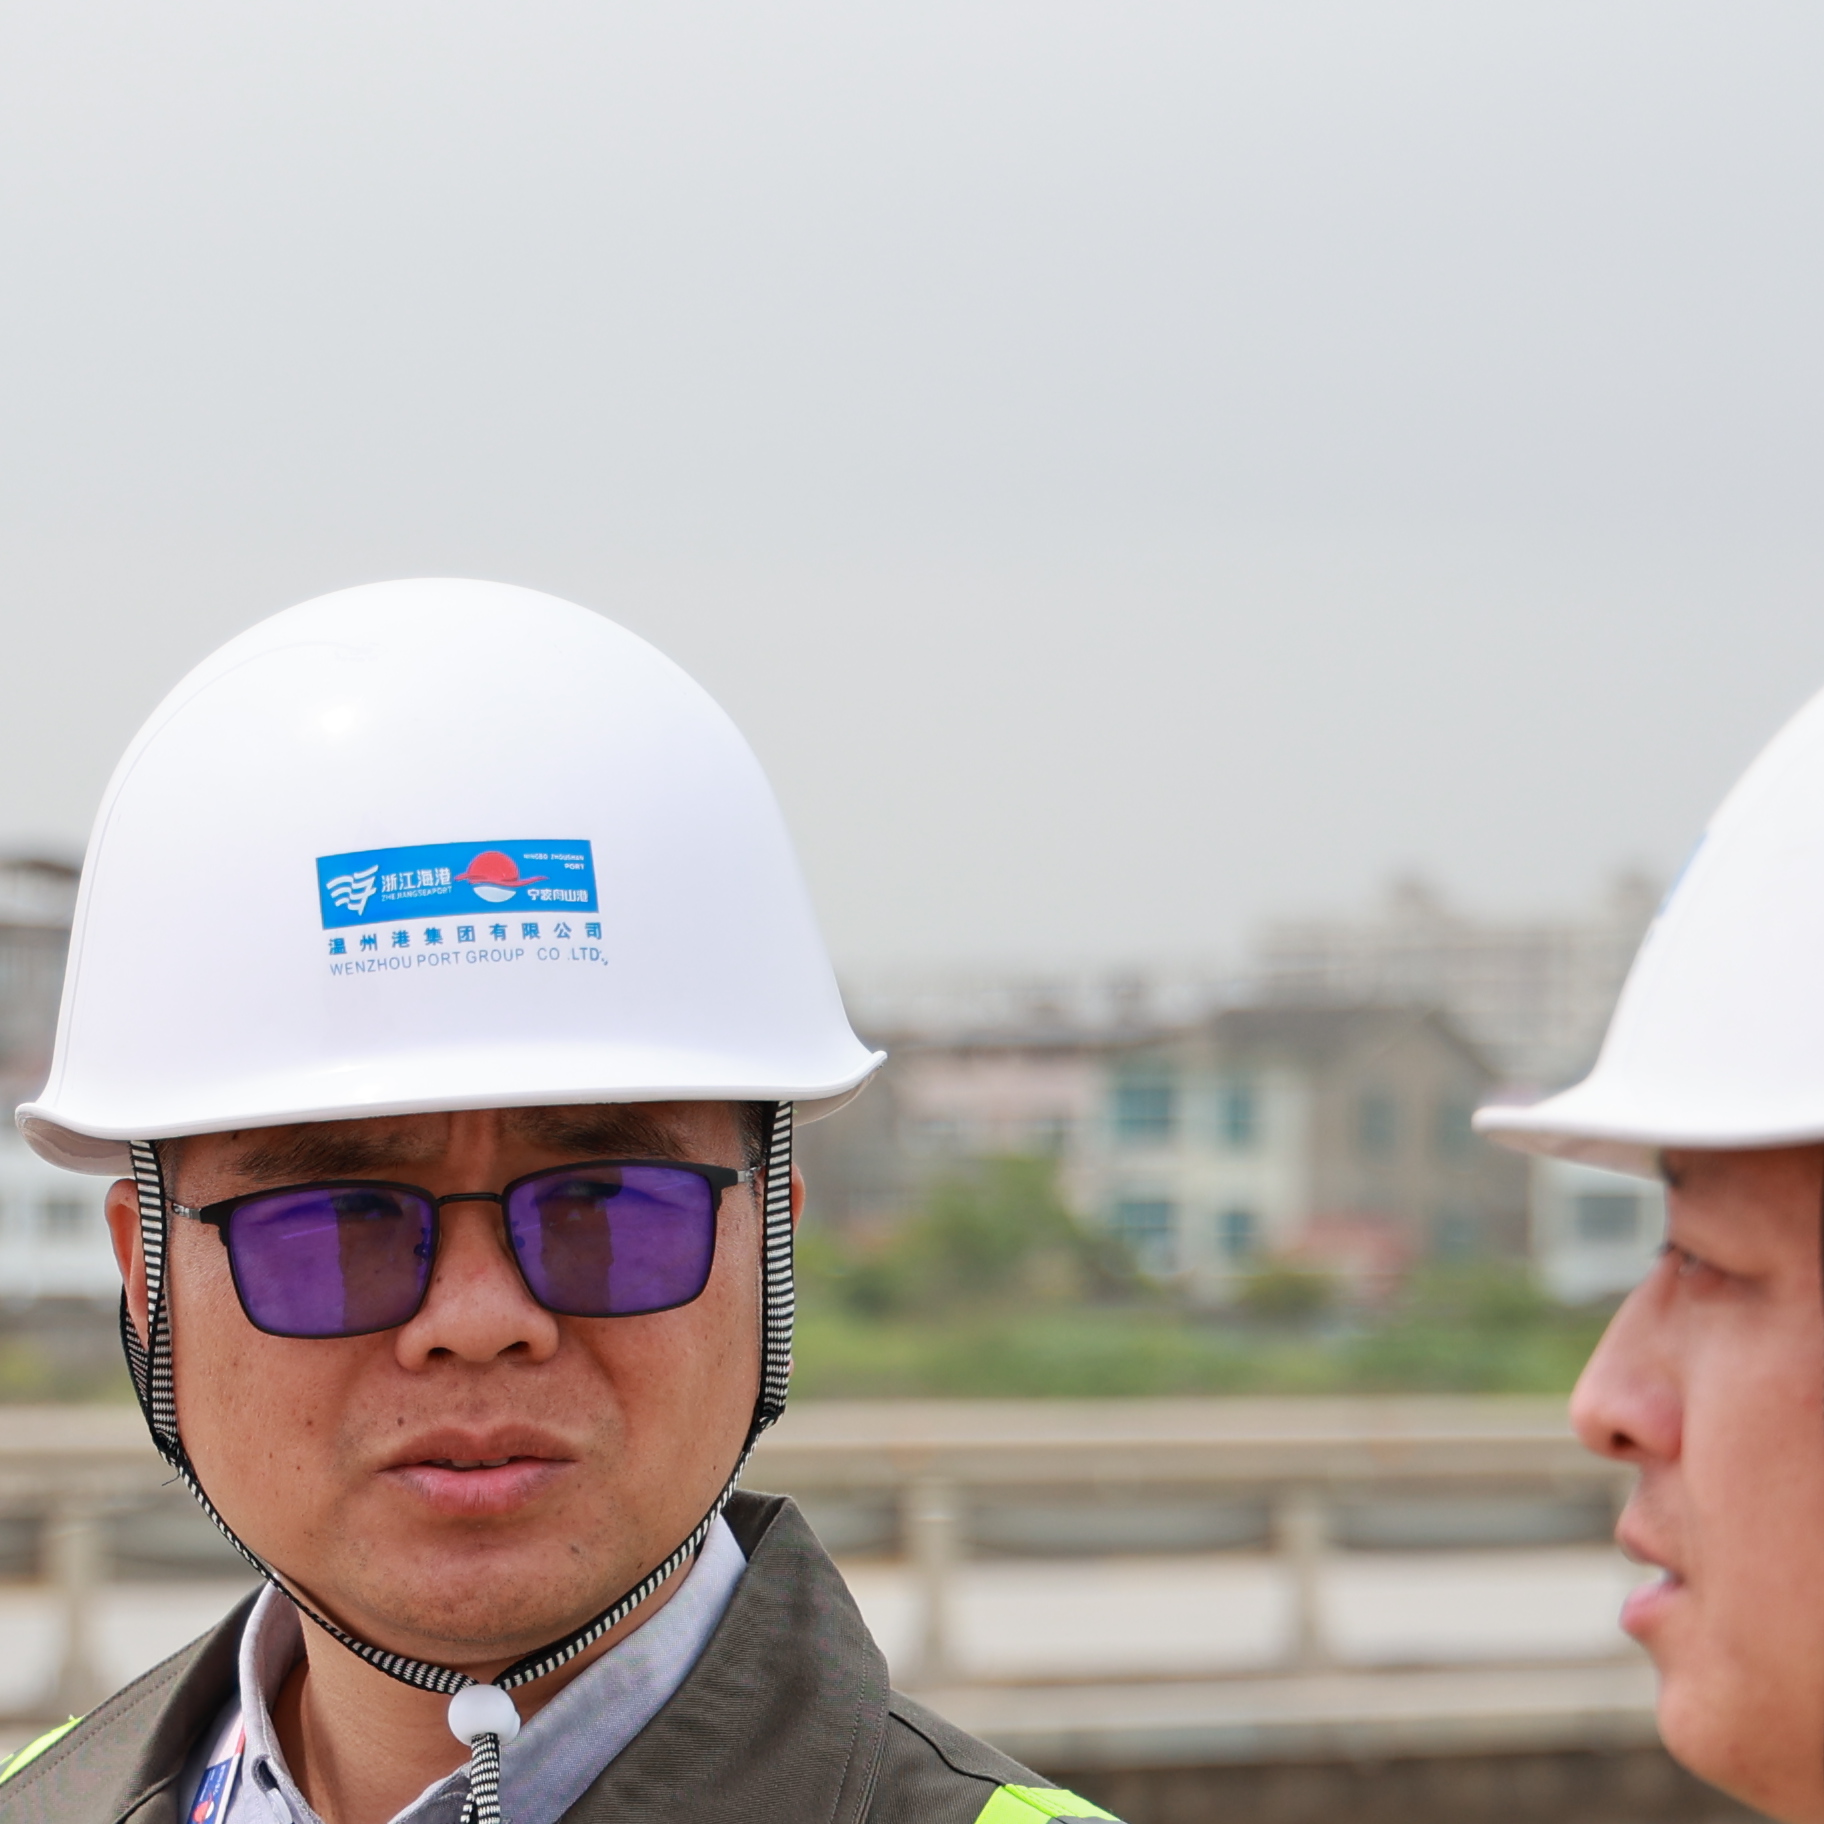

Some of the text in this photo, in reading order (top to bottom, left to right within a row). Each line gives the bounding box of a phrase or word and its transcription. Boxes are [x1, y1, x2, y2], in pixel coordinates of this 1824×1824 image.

[563, 862, 584, 870] PORT
[381, 867, 452, 893] 浙江海港
[328, 922, 603, 956] 温州港集团有限公司
[329, 954, 412, 976] WENZHOU
[416, 950, 460, 968] PORT
[466, 947, 525, 965] GROUP
